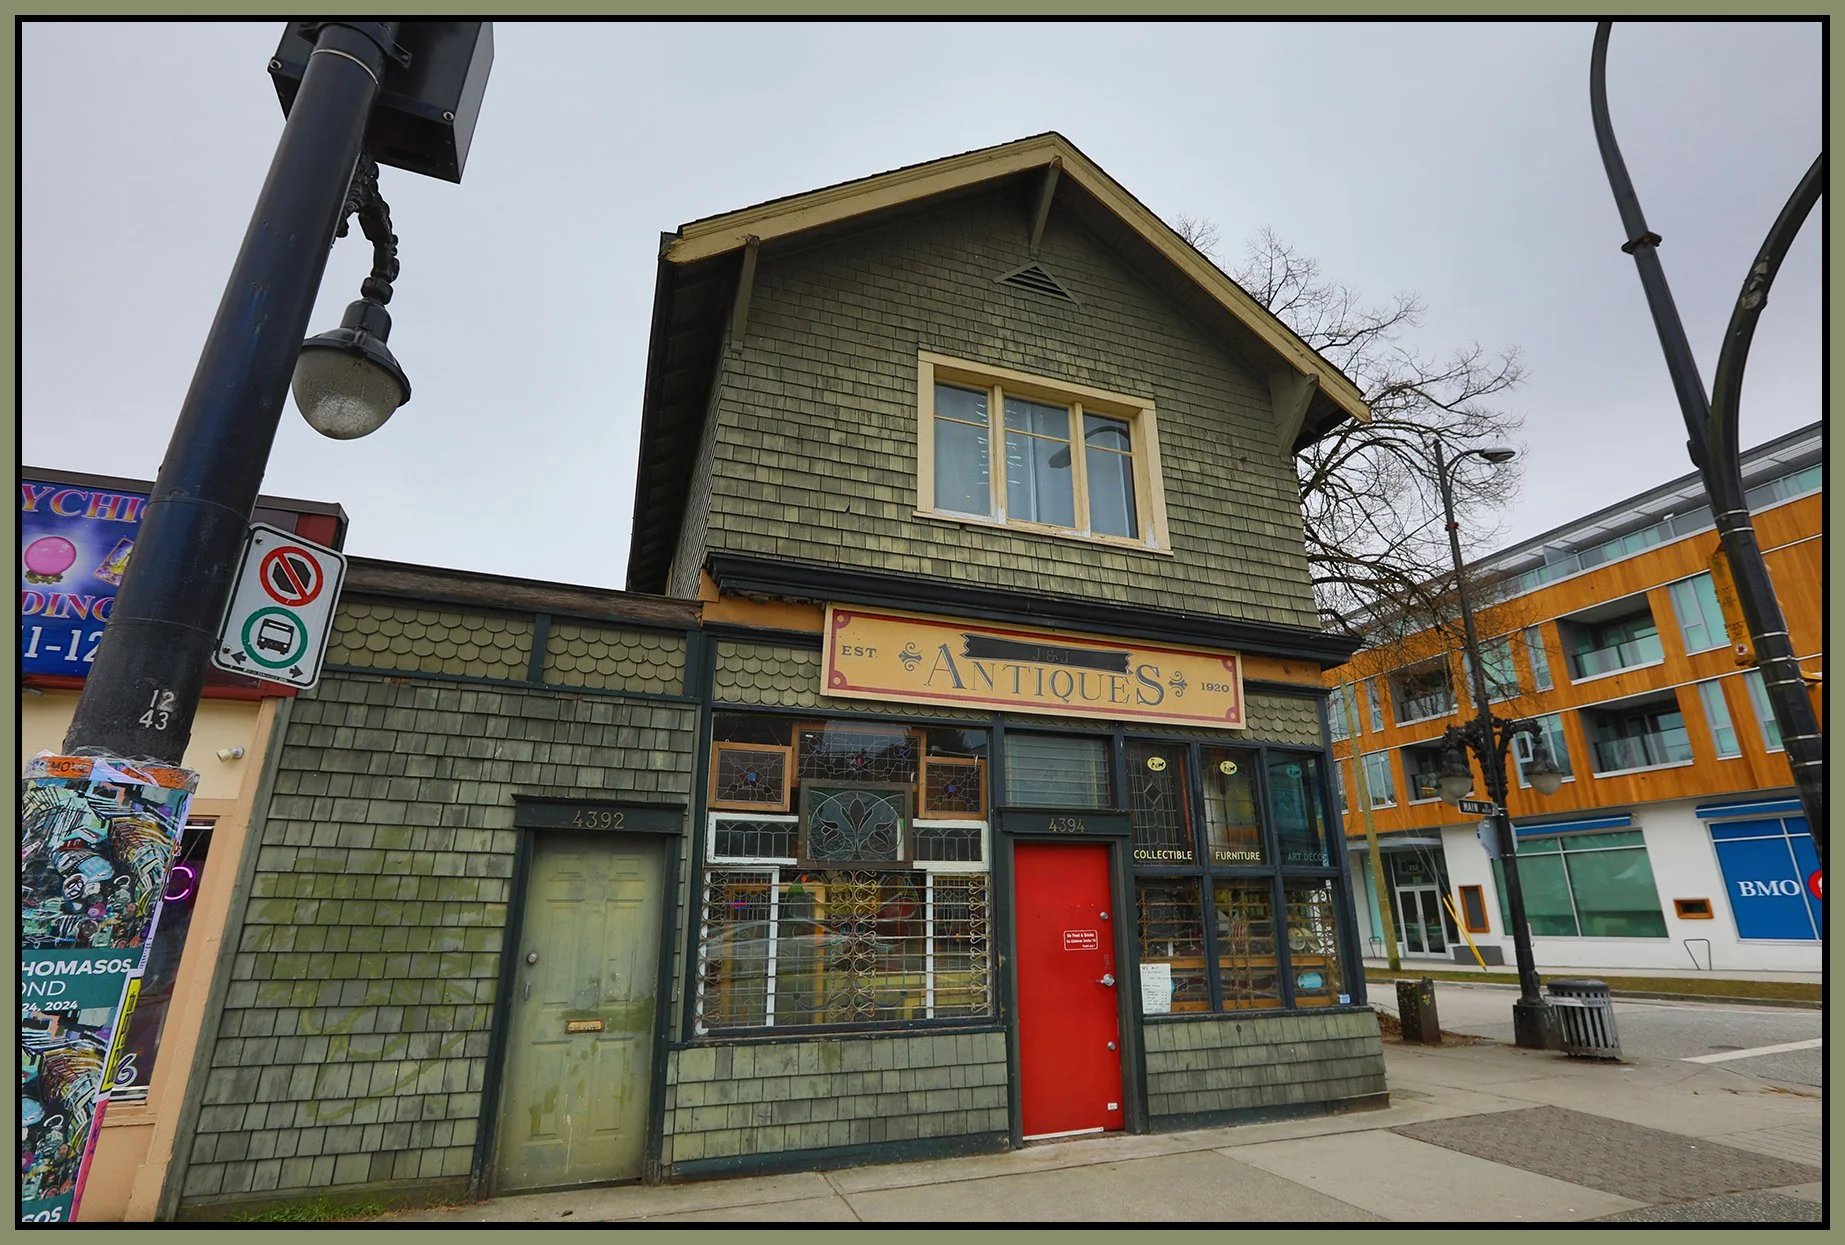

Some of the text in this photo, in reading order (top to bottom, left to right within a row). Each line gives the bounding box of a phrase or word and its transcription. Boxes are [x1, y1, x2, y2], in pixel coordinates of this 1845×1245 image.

[22, 484, 149, 523] YCHI
[1201, 682, 1230, 693] 1920
[150, 689, 174, 712] 12
[139, 709, 169, 730] 43
[572, 810, 625, 829] 4392
[1049, 817, 1085, 833] 4394
[1133, 850, 1193, 861] COLLECTIBLE
[1215, 851, 1261, 862] FURNITURE
[1287, 852, 1302, 862] ART
[1736, 879, 1801, 897] BMO
[44, 1000, 78, 1011] 2024
